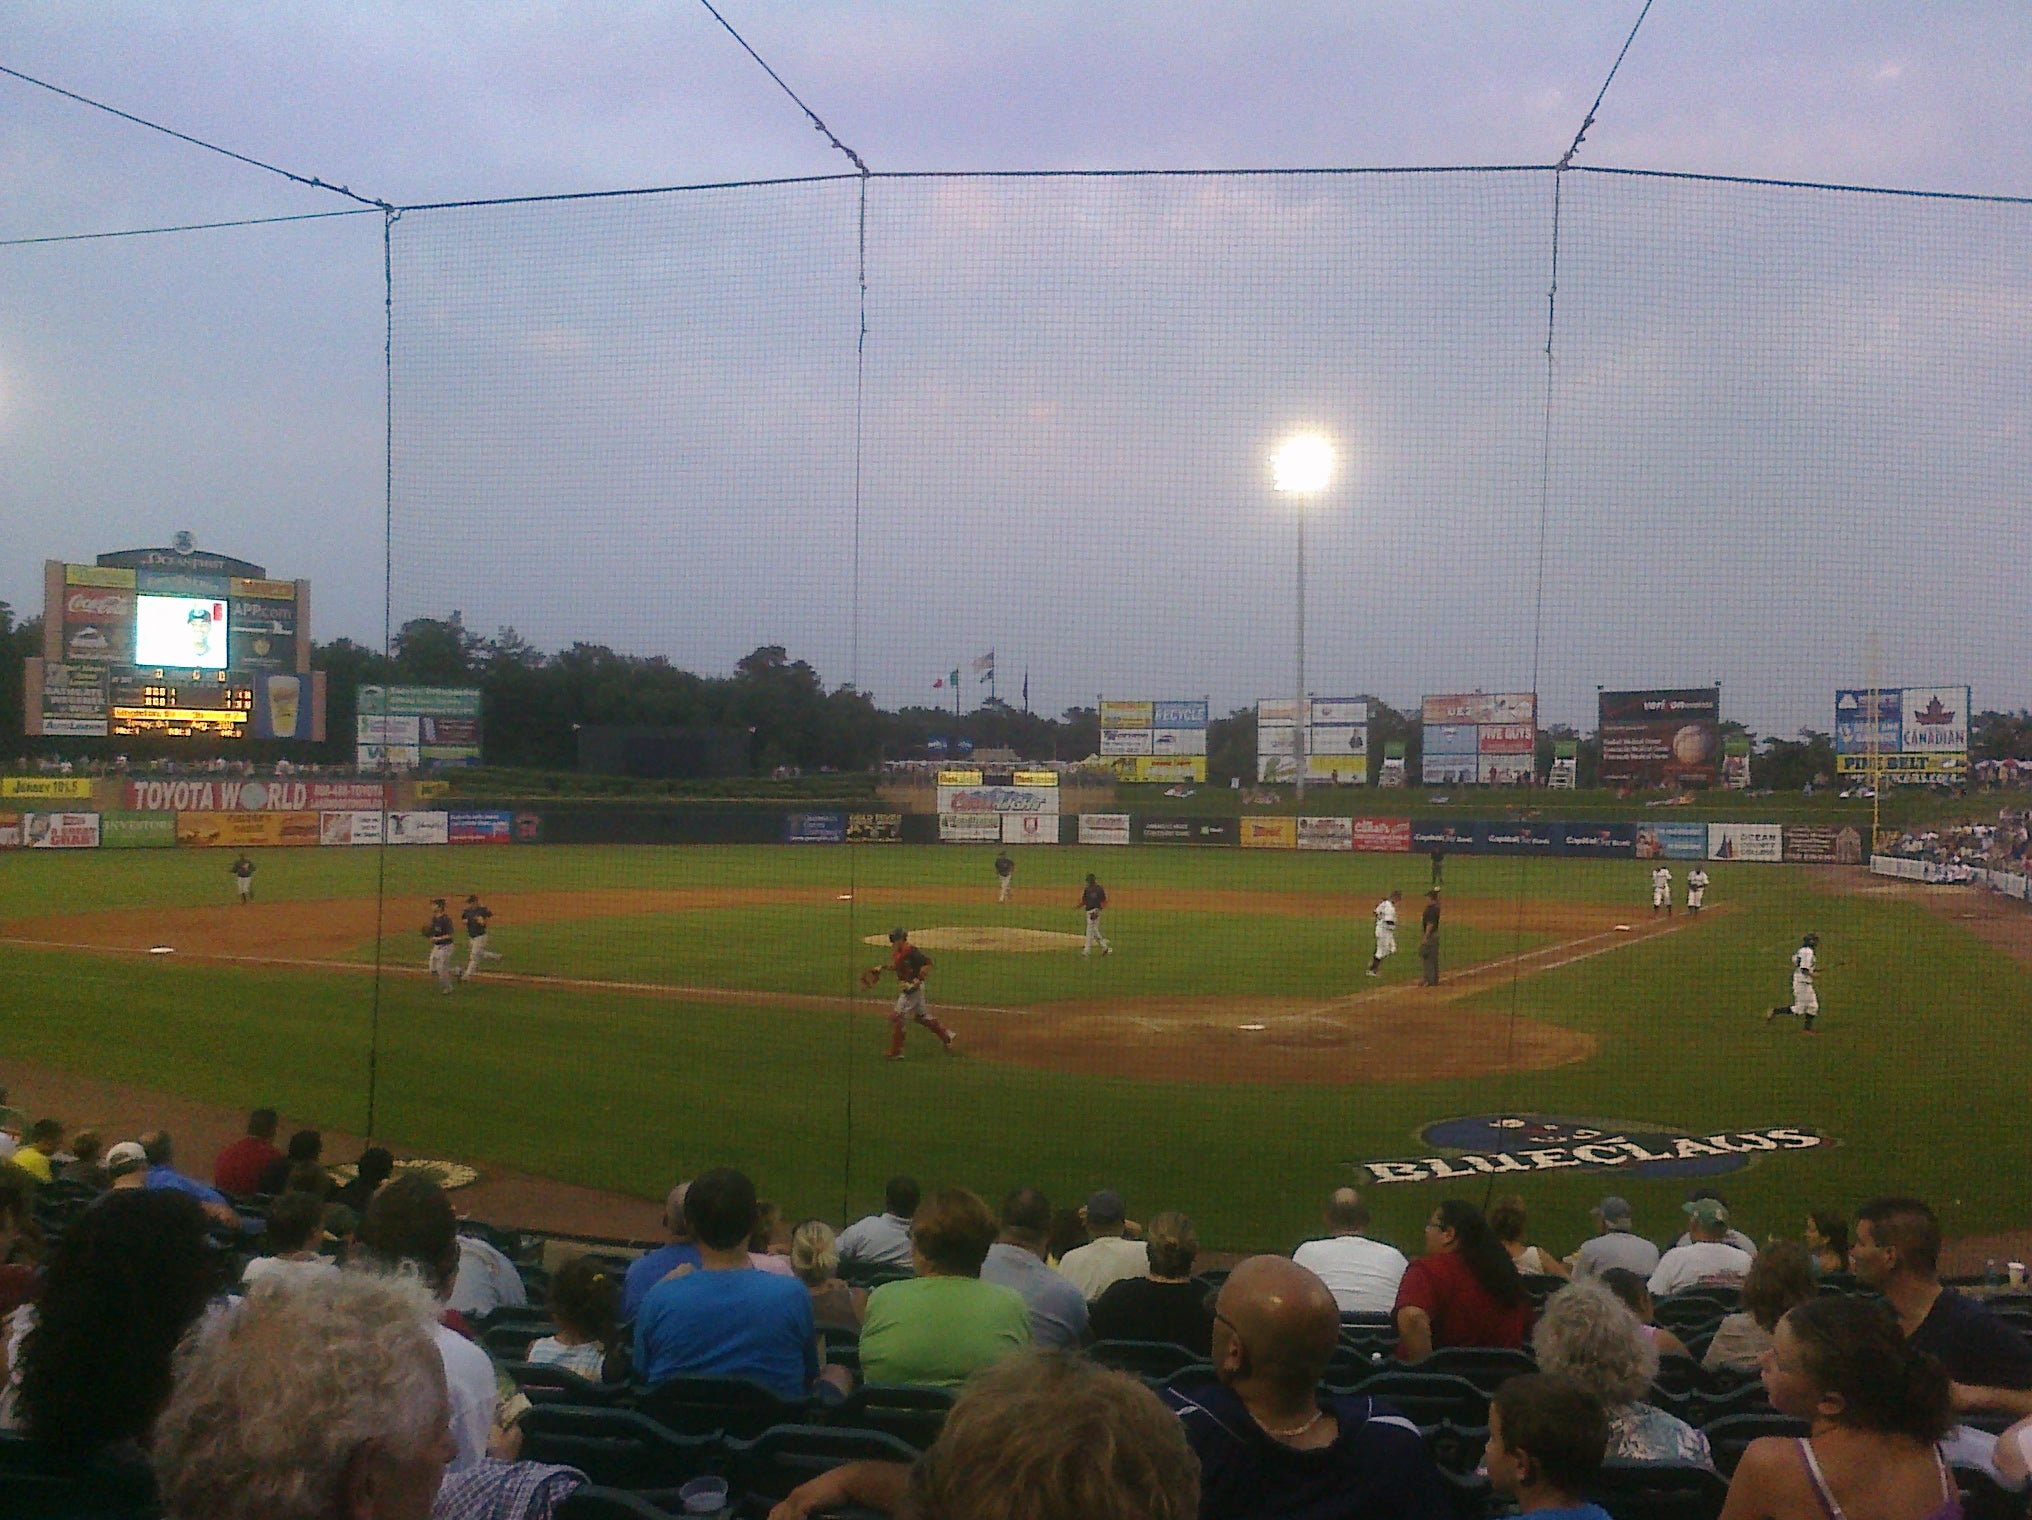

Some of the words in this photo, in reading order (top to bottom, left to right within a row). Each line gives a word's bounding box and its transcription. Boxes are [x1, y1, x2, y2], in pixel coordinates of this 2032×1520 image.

[1903, 729, 1965, 745] CANADIAN
[133, 782, 214, 810] TOYOTA
[1363, 1127, 1822, 1185] BLUECLAWS
